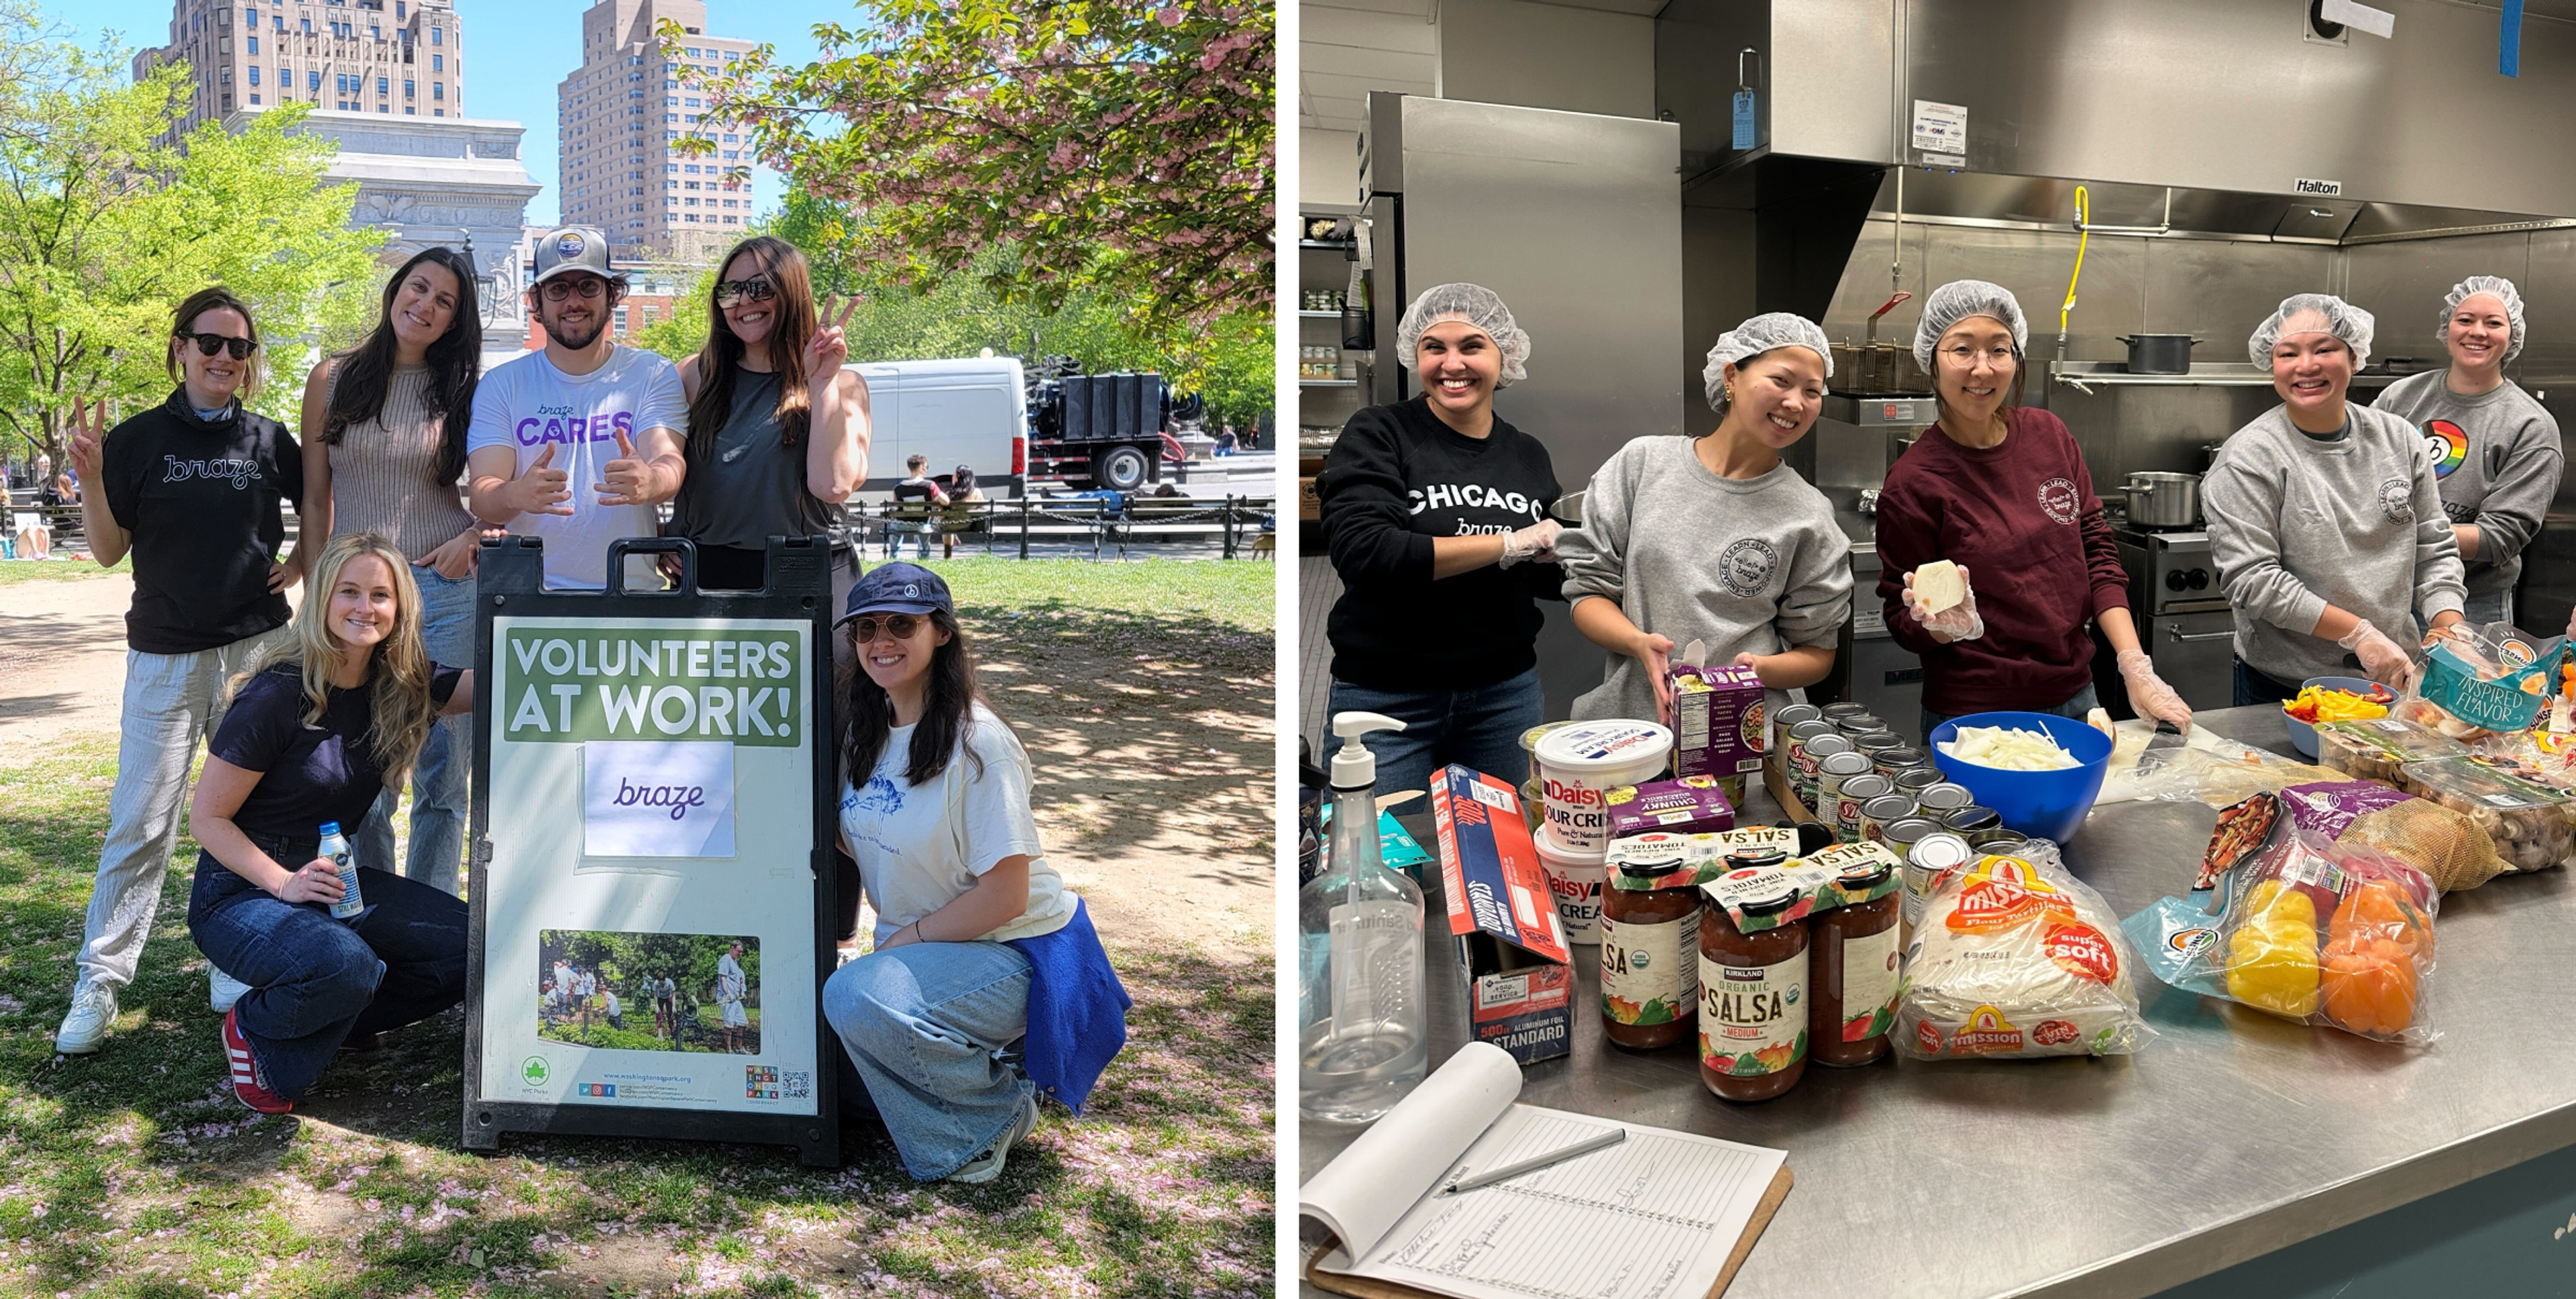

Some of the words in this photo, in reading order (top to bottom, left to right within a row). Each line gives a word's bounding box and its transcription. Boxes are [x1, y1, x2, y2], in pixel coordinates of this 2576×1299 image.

[2297, 179, 2339, 195] Halton
[537, 403, 574, 420] braze
[517, 411, 633, 447] CARES
[163, 454, 262, 490] braze
[1407, 484, 1543, 523] CHICAGO
[1725, 541, 1750, 558] LEARN
[1756, 543, 1773, 560] LEAD
[1721, 564, 1740, 594] ENGAGE
[511, 638, 792, 678] VOLUNTEERS
[2458, 676, 2523, 709] INSPIRED
[510, 683, 581, 732] AT
[599, 684, 791, 737] WORK!
[2457, 692, 2512, 722] FLAVOR
[1576, 737, 1613, 754] CREAM
[1604, 733, 1649, 753] Daisy
[612, 777, 705, 821] braze
[1551, 779, 1603, 810] Daisy
[1641, 792, 1690, 802] GUACAMOLE
[1452, 794, 1487, 827] 500ft
[1642, 798, 1697, 811] CHUNKY
[1557, 827, 1570, 837] Pure
[1570, 829, 1579, 838] &
[1721, 829, 1790, 843] SALSA
[1621, 841, 1687, 850] TOMATOES
[1809, 841, 1878, 866] SALSA
[1833, 854, 1876, 868] ORGANIC
[1721, 872, 1786, 892] TOMATOES
[1731, 883, 1768, 894] RIPENED
[1768, 878, 1786, 886] VINE
[1468, 880, 1503, 932] STANDARD
[1966, 916, 2004, 926] Flour
[2006, 901, 2064, 919] Tortillas
[1680, 913, 1699, 927] Nutrition
[2061, 935, 2104, 949] super
[2055, 944, 2111, 972] soft
[1490, 991, 1518, 1000] SERVICE
[1495, 984, 1512, 992] FOOD
[1719, 981, 1770, 993] ORGANIC
[1709, 988, 1783, 1023] SALSA
[1514, 1019, 1550, 1032] ALUMINUM
[1550, 1016, 1564, 1025] FOIL
[1727, 1027, 1758, 1037] MEDIUM
[1493, 1025, 1564, 1049] STANDARD
[1957, 1033, 2020, 1045] mission
[2035, 1025, 2068, 1042] TWIN
[603, 1073, 692, 1084] www.washingtonsqpark.org
[747, 1090, 777, 1098] PARK
